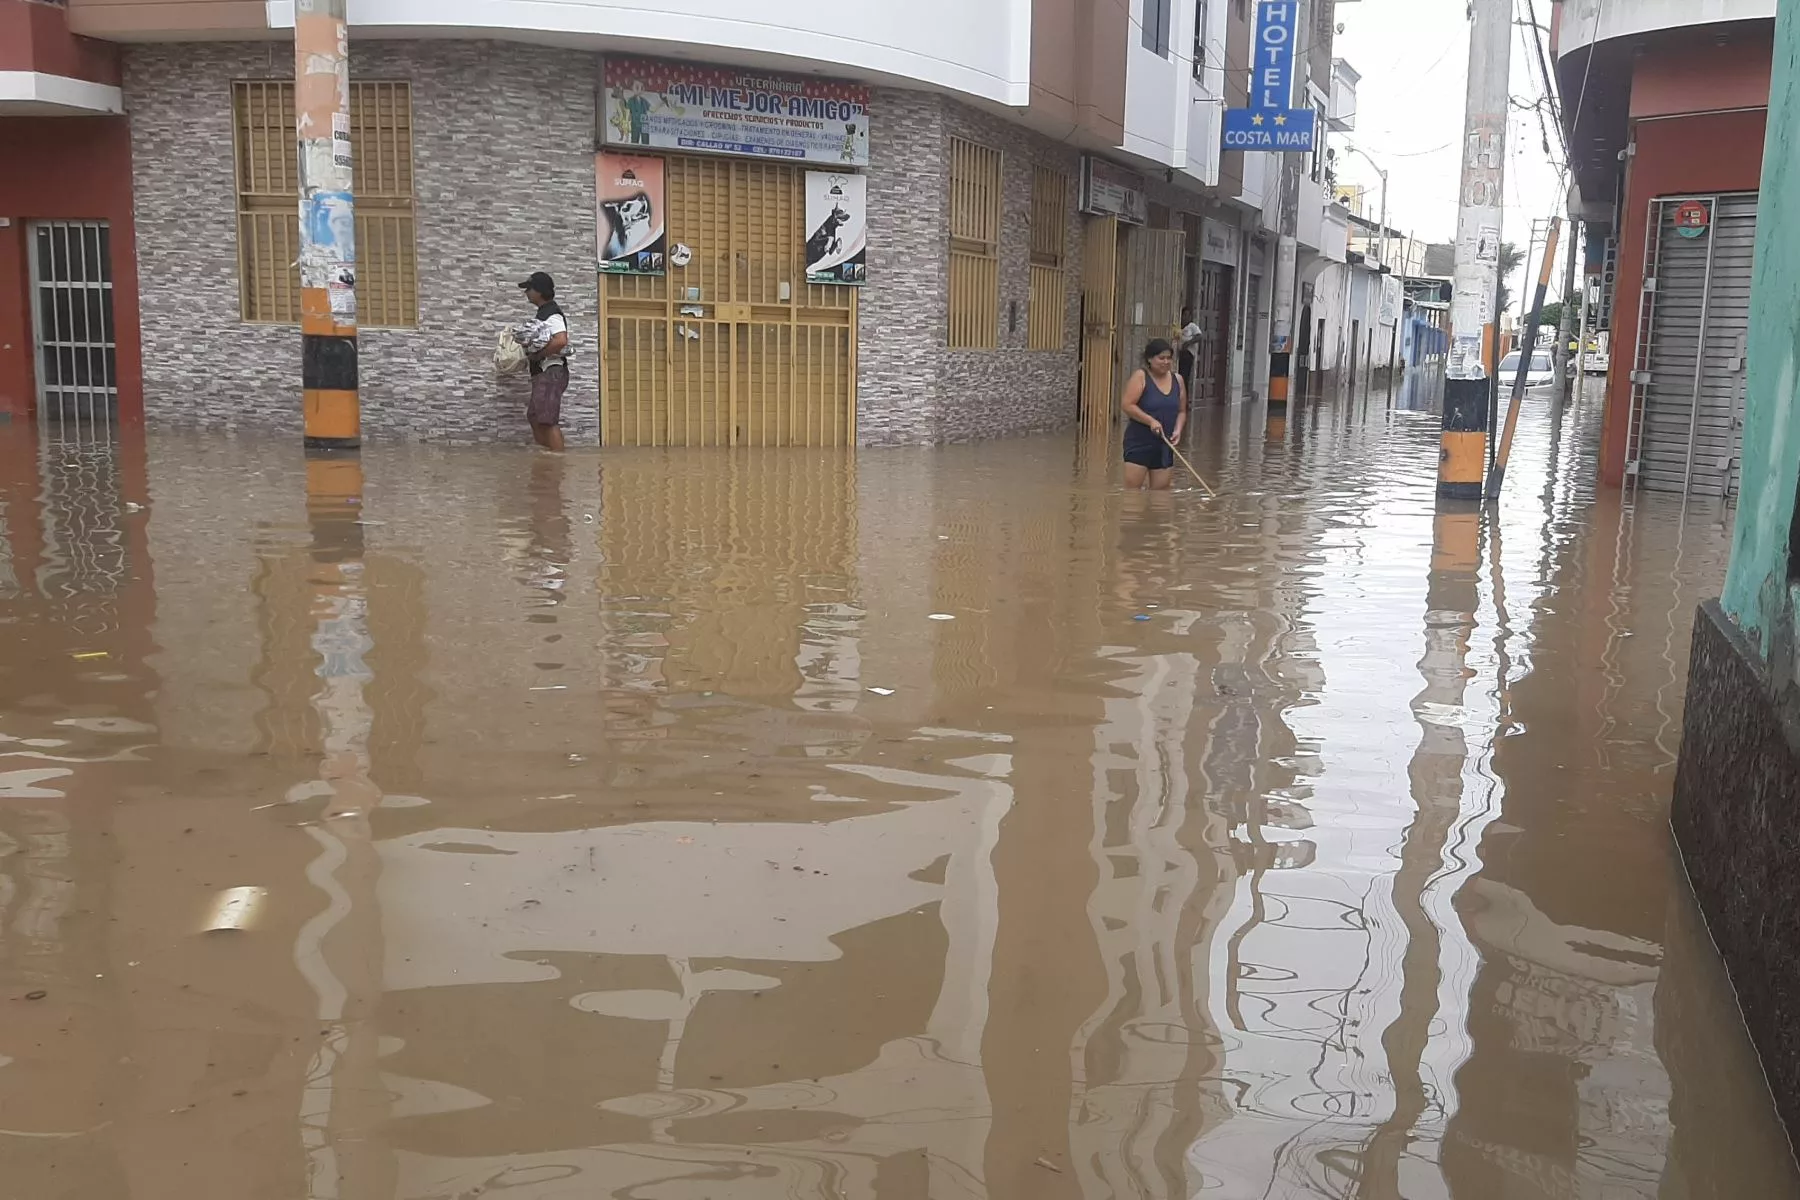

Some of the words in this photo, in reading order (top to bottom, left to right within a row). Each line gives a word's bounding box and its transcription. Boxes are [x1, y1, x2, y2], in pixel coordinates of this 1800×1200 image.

[1262, 4, 1288, 108] HOTEL
[735, 76, 802, 93] VETERINARIA
[785, 118, 824, 130] PRODUCTOS
[696, 140, 723, 149] CALLAO
[1225, 131, 1272, 145] COSTA
[1276, 131, 1310, 145] MAR
